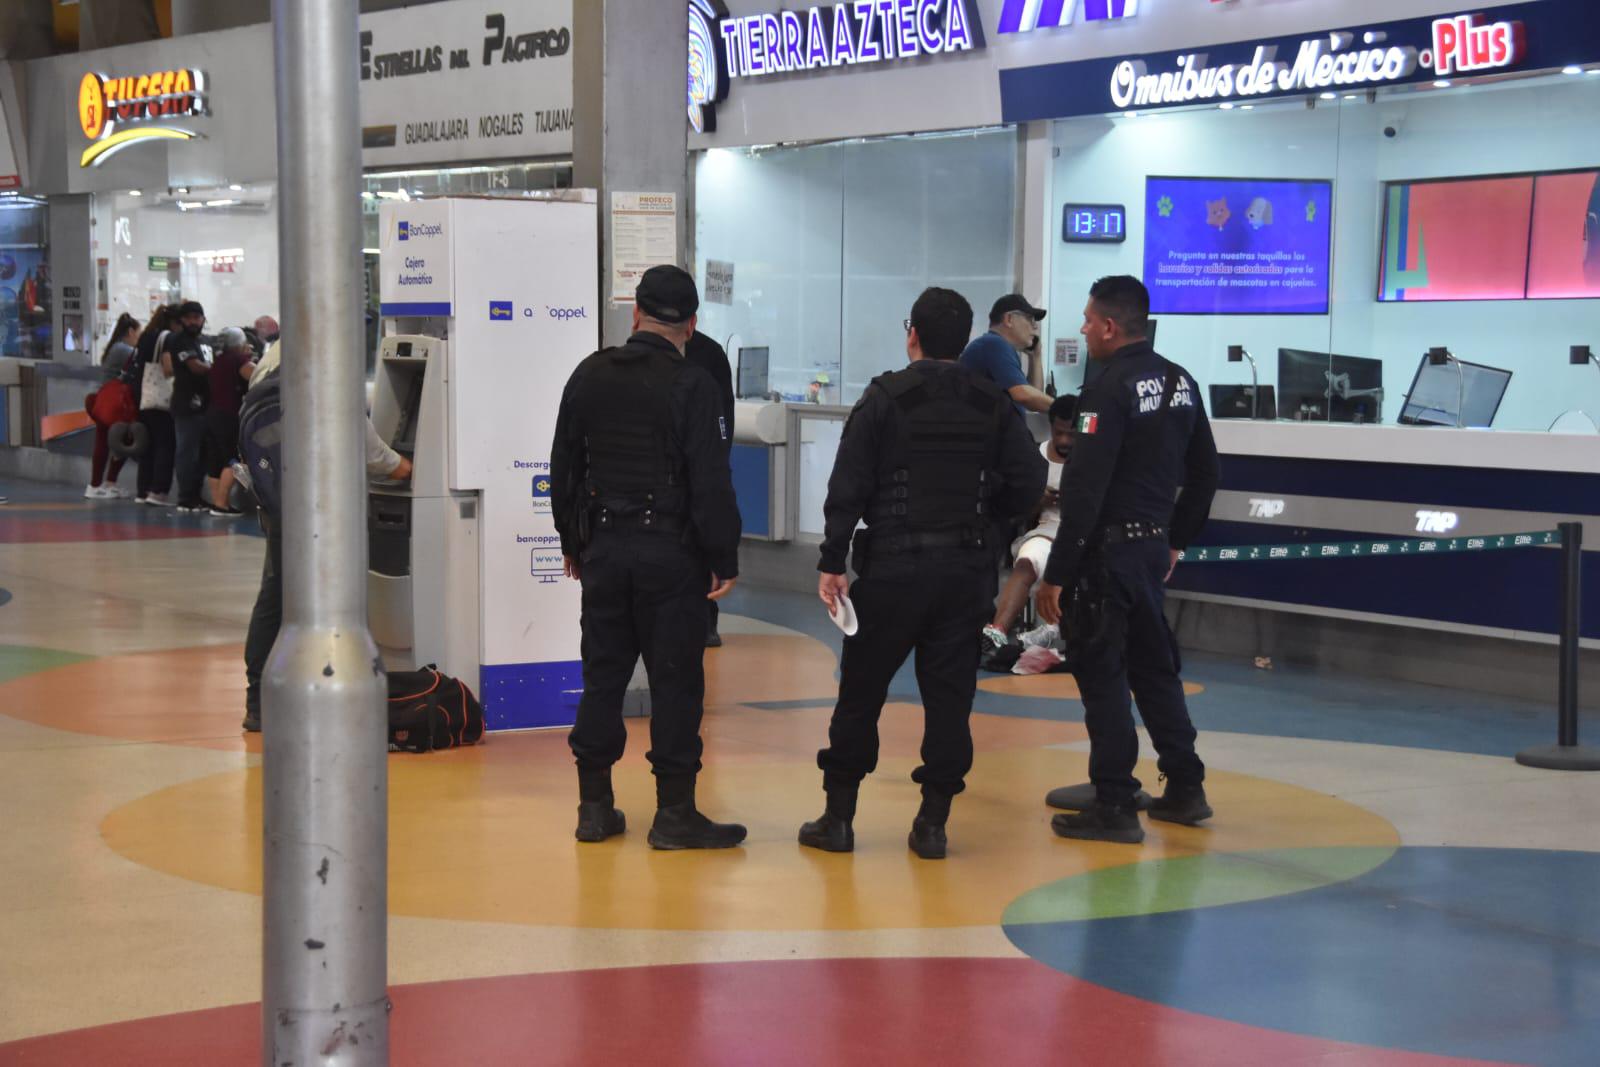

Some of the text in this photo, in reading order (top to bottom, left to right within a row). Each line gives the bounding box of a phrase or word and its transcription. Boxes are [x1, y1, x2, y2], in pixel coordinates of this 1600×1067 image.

[1110, 54, 1234, 107] Omnibus
[1235, 45, 1276, 95] de
[1432, 15, 1512, 75] Plus
[405, 108, 574, 145] GUADALAJARA NOGALES TIJUANA
[409, 222, 443, 239] BanCoppel
[1075, 212, 1122, 234] 13:17
[513, 460, 551, 470] Descarg
